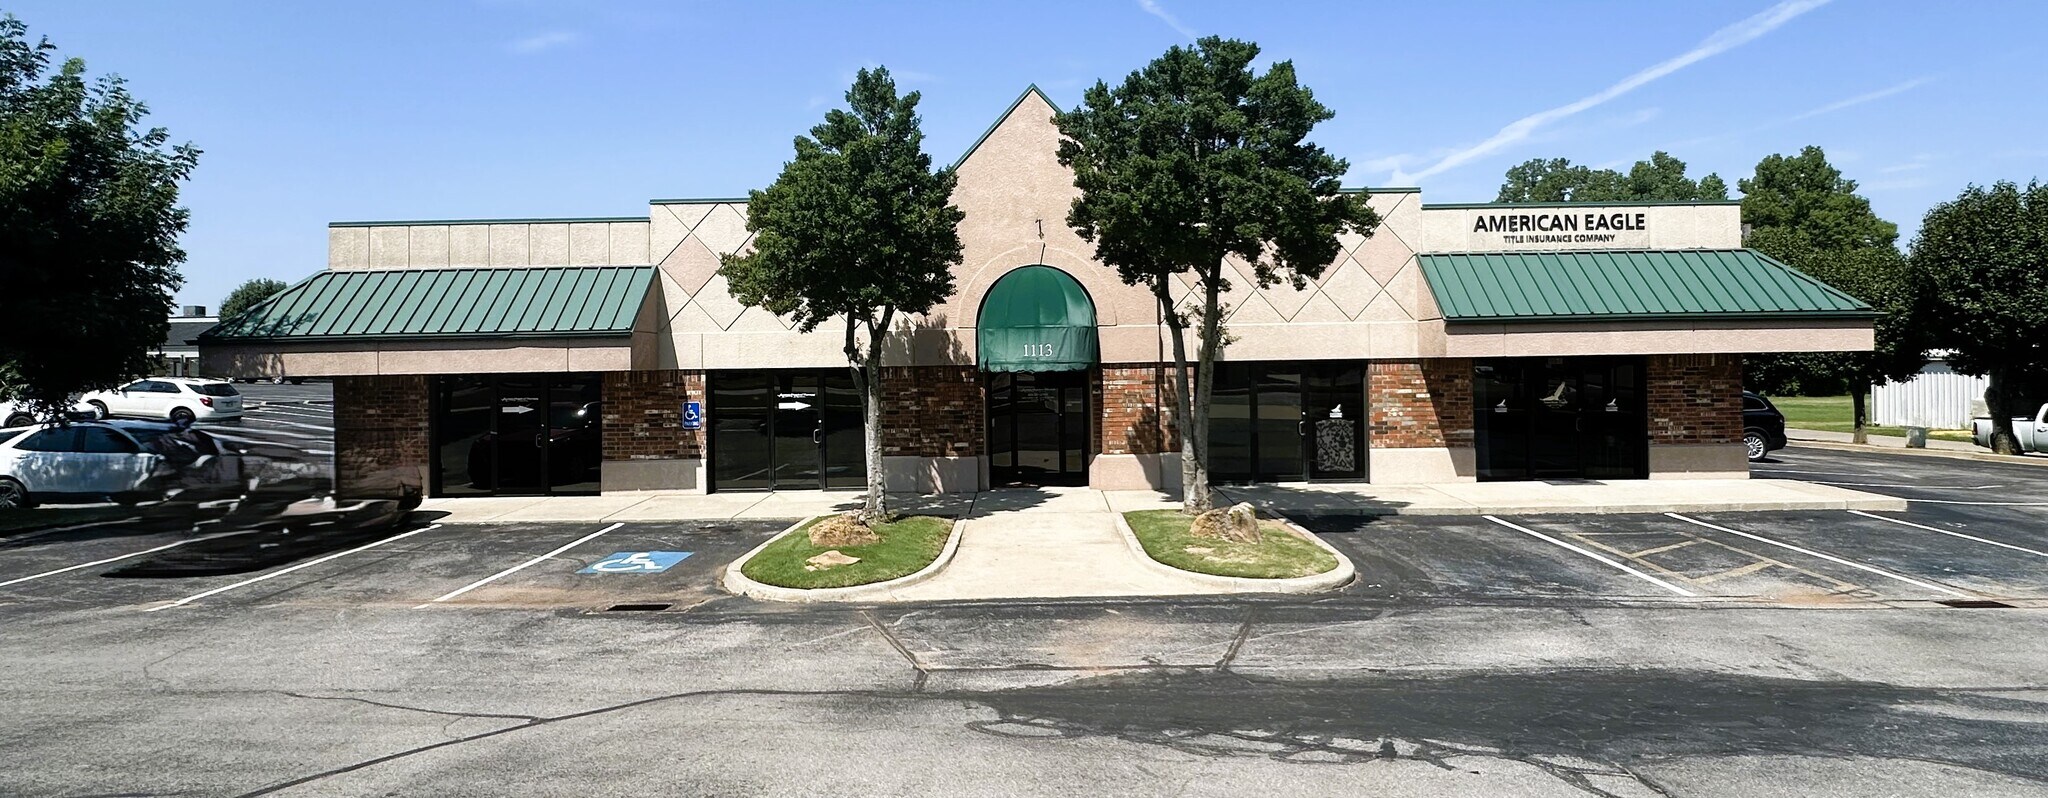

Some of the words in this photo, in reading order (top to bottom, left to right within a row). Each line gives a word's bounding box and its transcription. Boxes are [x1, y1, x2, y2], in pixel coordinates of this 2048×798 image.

[1473, 214, 1578, 232] AMERICAN
[1584, 213, 1646, 230] EAGLE
[1503, 235, 1524, 243] TITLE
[1526, 234, 1572, 243] INSURANCE
[1574, 234, 1615, 242] COMPANY
[1023, 343, 1053, 357] 1113
